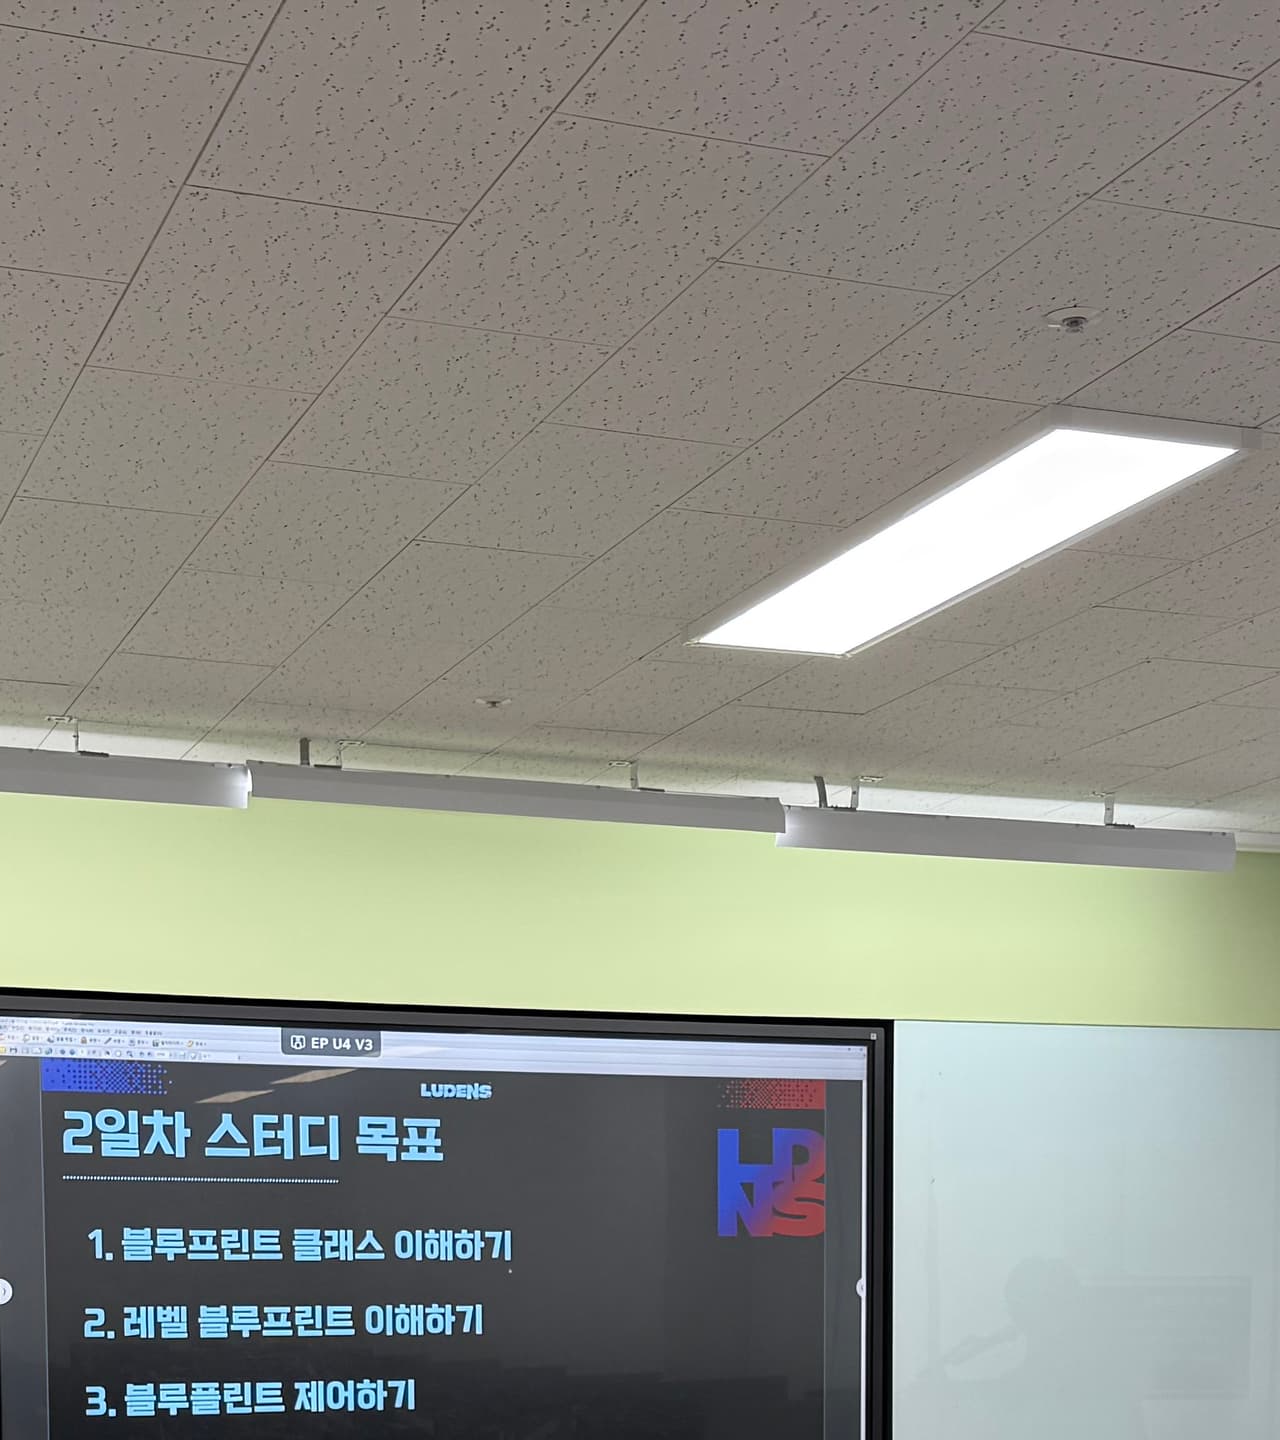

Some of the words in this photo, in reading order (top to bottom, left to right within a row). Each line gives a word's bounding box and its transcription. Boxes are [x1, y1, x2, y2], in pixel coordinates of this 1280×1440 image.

[310, 1036, 328, 1050] EP
[332, 1037, 351, 1050] U4
[355, 1038, 374, 1051] V3
[420, 1082, 493, 1101] LUDENS
[62, 1109, 192, 1159] 2일차
[205, 1113, 341, 1161] 스터디
[355, 1116, 445, 1162] 목표
[88, 1228, 114, 1261] 1.
[121, 1227, 284, 1262] 블루프린트
[291, 1228, 386, 1262] 클래스
[394, 1228, 512, 1262] 이해하기
[83, 1307, 116, 1340] 2.
[123, 1305, 189, 1339] 레벨
[197, 1304, 356, 1339] 블루프린트
[364, 1303, 484, 1337] 이해하기
[85, 1385, 117, 1417] 3.
[124, 1382, 286, 1417] 블루플린트
[293, 1378, 416, 1413] 제어하기
